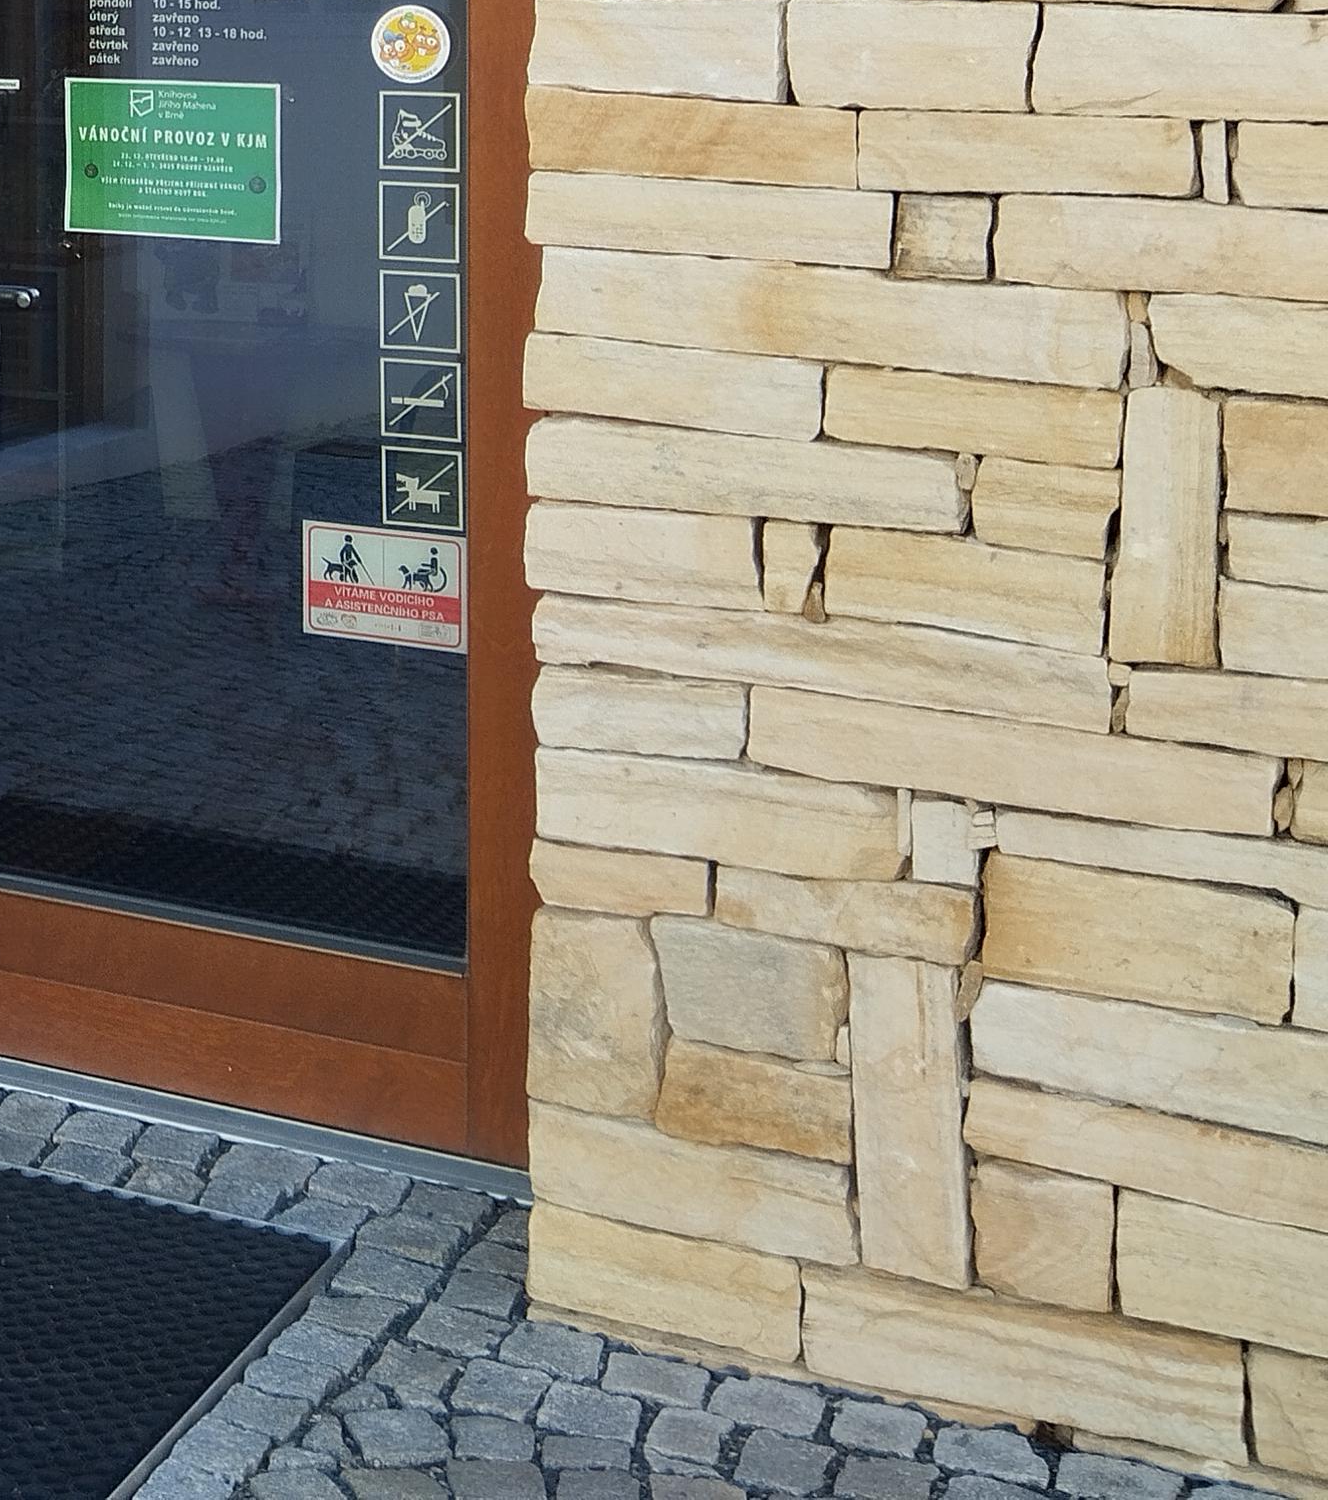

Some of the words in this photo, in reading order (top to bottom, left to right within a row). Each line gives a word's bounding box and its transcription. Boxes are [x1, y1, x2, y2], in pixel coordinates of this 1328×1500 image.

[89, 11, 119, 24] úterý
[152, 12, 200, 24] zavřeno
[89, 25, 126, 36] středa
[152, 26, 166, 37] 10
[178, 27, 191, 38] 12
[198, 28, 212, 39] 13
[223, 28, 237, 40] 18
[240, 29, 267, 40] hod.
[89, 38, 129, 50] čtvrtek
[152, 40, 199, 52] zavřeno
[89, 53, 121, 66] pátek
[152, 54, 199, 67] zavřeno
[158, 90, 197, 100] Knihovna
[158, 100, 182, 110] Jiřího
[182, 101, 217, 111] Mahena
[165, 110, 185, 120] Brně
[78, 123, 147, 144] VÁNOČNÍ
[154, 131, 215, 146] PROVOZ
[221, 132, 230, 147] V
[237, 133, 268, 149] KJM
[324, 598, 333, 608] A
[335, 600, 419, 619] ASISTENČNÍHO
[421, 610, 445, 622] PSA
